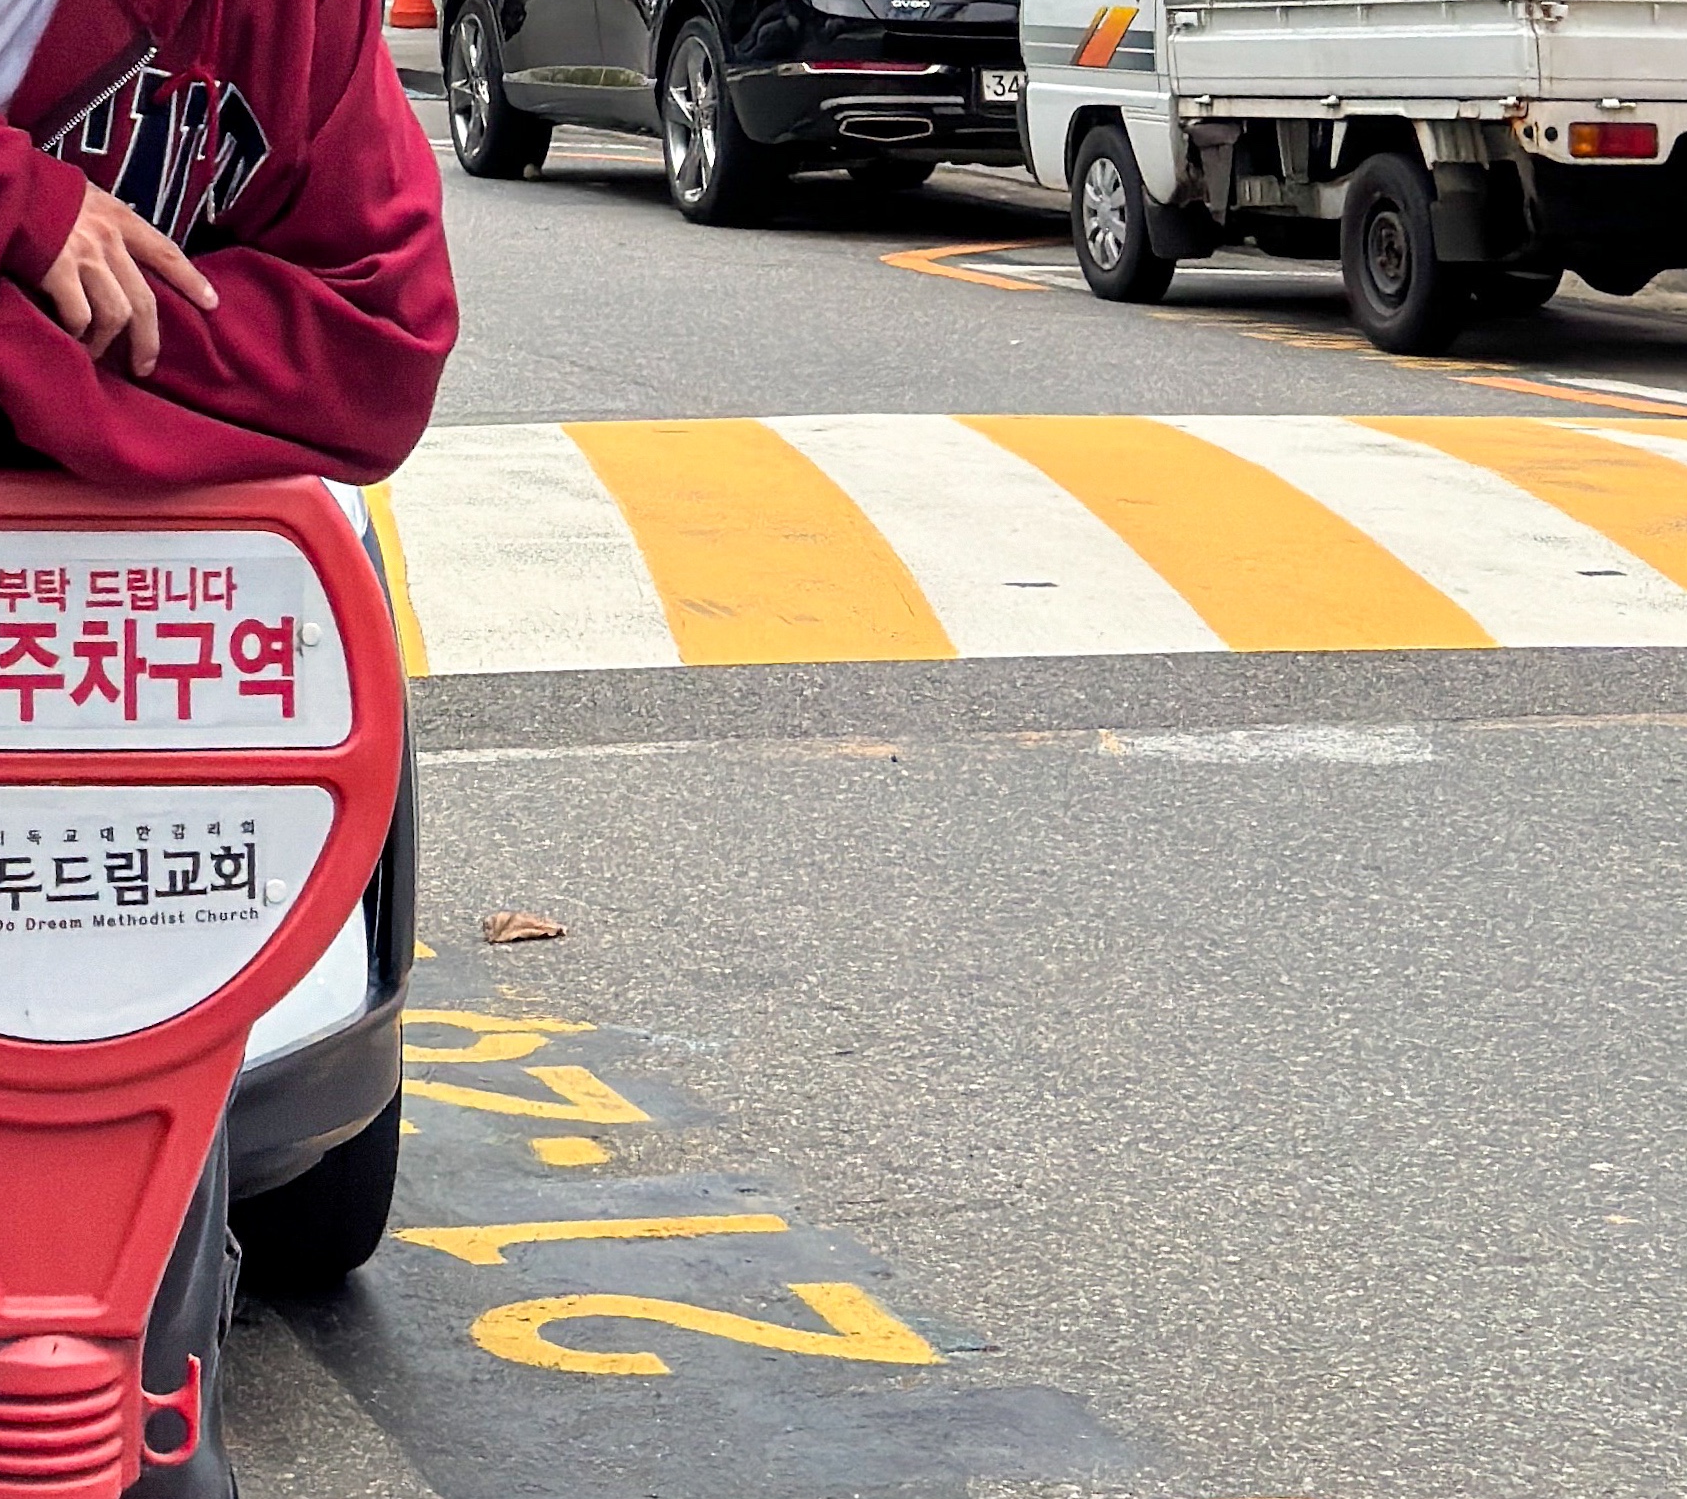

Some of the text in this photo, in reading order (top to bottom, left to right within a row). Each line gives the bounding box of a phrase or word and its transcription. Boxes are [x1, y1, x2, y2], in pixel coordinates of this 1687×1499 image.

[992, 74, 1028, 97] 34
[86, 565, 238, 612] 드립니다
[25, 916, 82, 931] Dream
[92, 911, 185, 928] Methodist
[195, 907, 259, 923] Church
